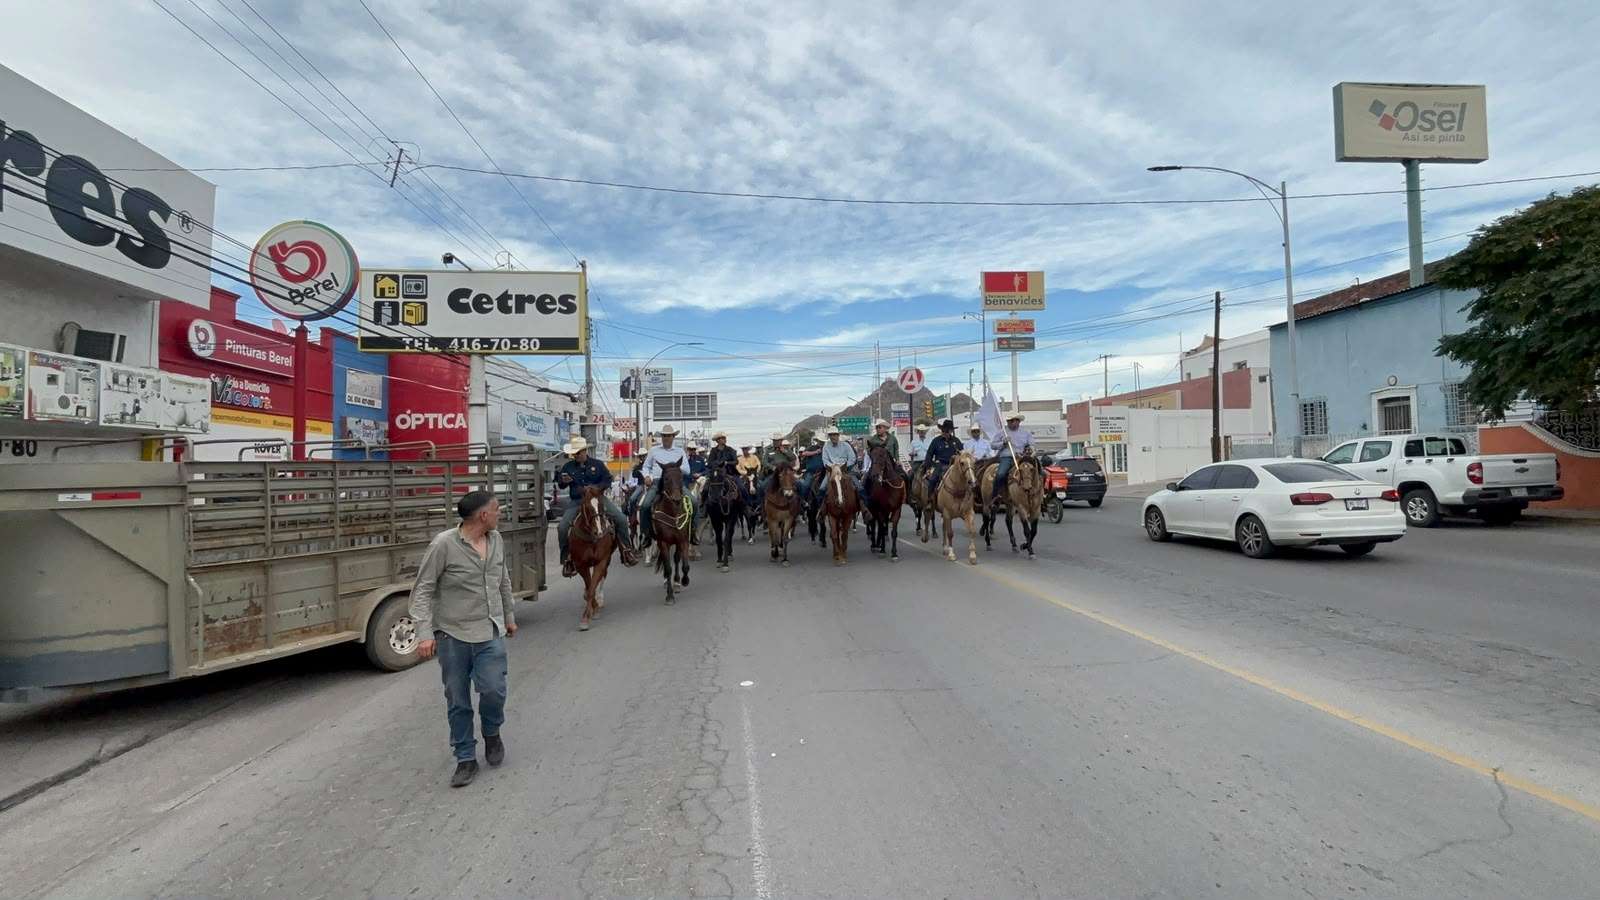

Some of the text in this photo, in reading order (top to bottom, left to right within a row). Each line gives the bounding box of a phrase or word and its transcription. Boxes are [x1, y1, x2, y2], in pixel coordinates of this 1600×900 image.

[1393, 101, 1467, 132] Osel
[1423, 134, 1436, 142] se
[1438, 133, 1465, 144] pinta
[288, 272, 340, 305] Berel
[985, 295, 1043, 306] benavides
[447, 287, 577, 315] Cetres
[225, 338, 267, 361] Pinturas
[269, 350, 293, 367] Berel
[449, 338, 541, 351] 416-70-80
[395, 409, 467, 430] ÓPTICA
